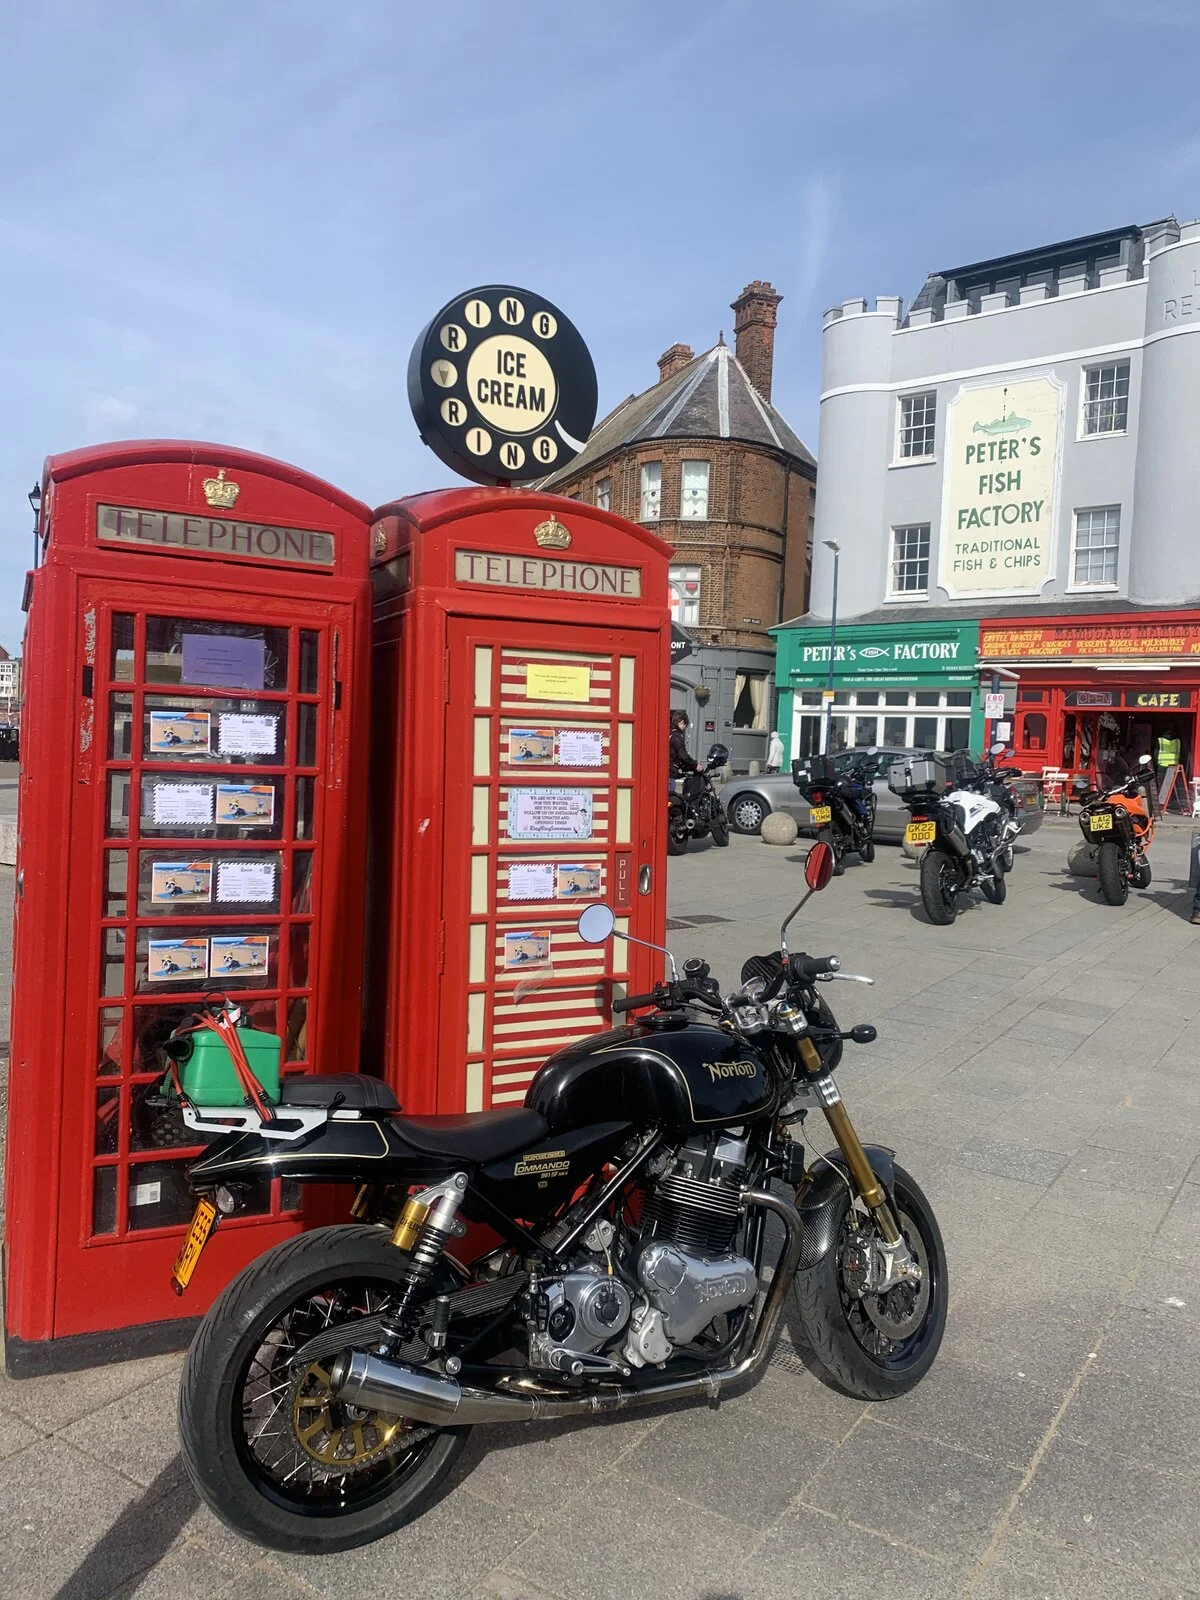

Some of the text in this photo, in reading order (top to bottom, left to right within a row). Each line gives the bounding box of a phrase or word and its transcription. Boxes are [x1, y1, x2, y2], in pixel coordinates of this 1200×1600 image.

[448, 300, 549, 349] RING
[497, 349, 526, 378] ICE
[477, 378, 546, 413] CREAM
[449, 401, 550, 466] RING
[966, 436, 1042, 465] PETER'S
[979, 470, 1021, 495] FISH
[957, 500, 1044, 530] FACTORY
[109, 508, 326, 562] TELEPHONE
[955, 537, 1040, 555] TRADITIONAL
[464, 554, 633, 594] TELEPHONE
[954, 555, 1041, 572] FISH & CHIPS
[894, 643, 960, 661] FACTORY
[1077, 640, 1107, 648] DESSERTS
[1137, 693, 1180, 706] CAFE
[908, 823, 934, 833] GK22
[1091, 816, 1110, 824] LA12
[1092, 822, 1109, 830] UKZ
[702, 1060, 757, 1083] Norton
[514, 1160, 570, 1176] COMMANDO
[695, 1276, 746, 1302] Norton
